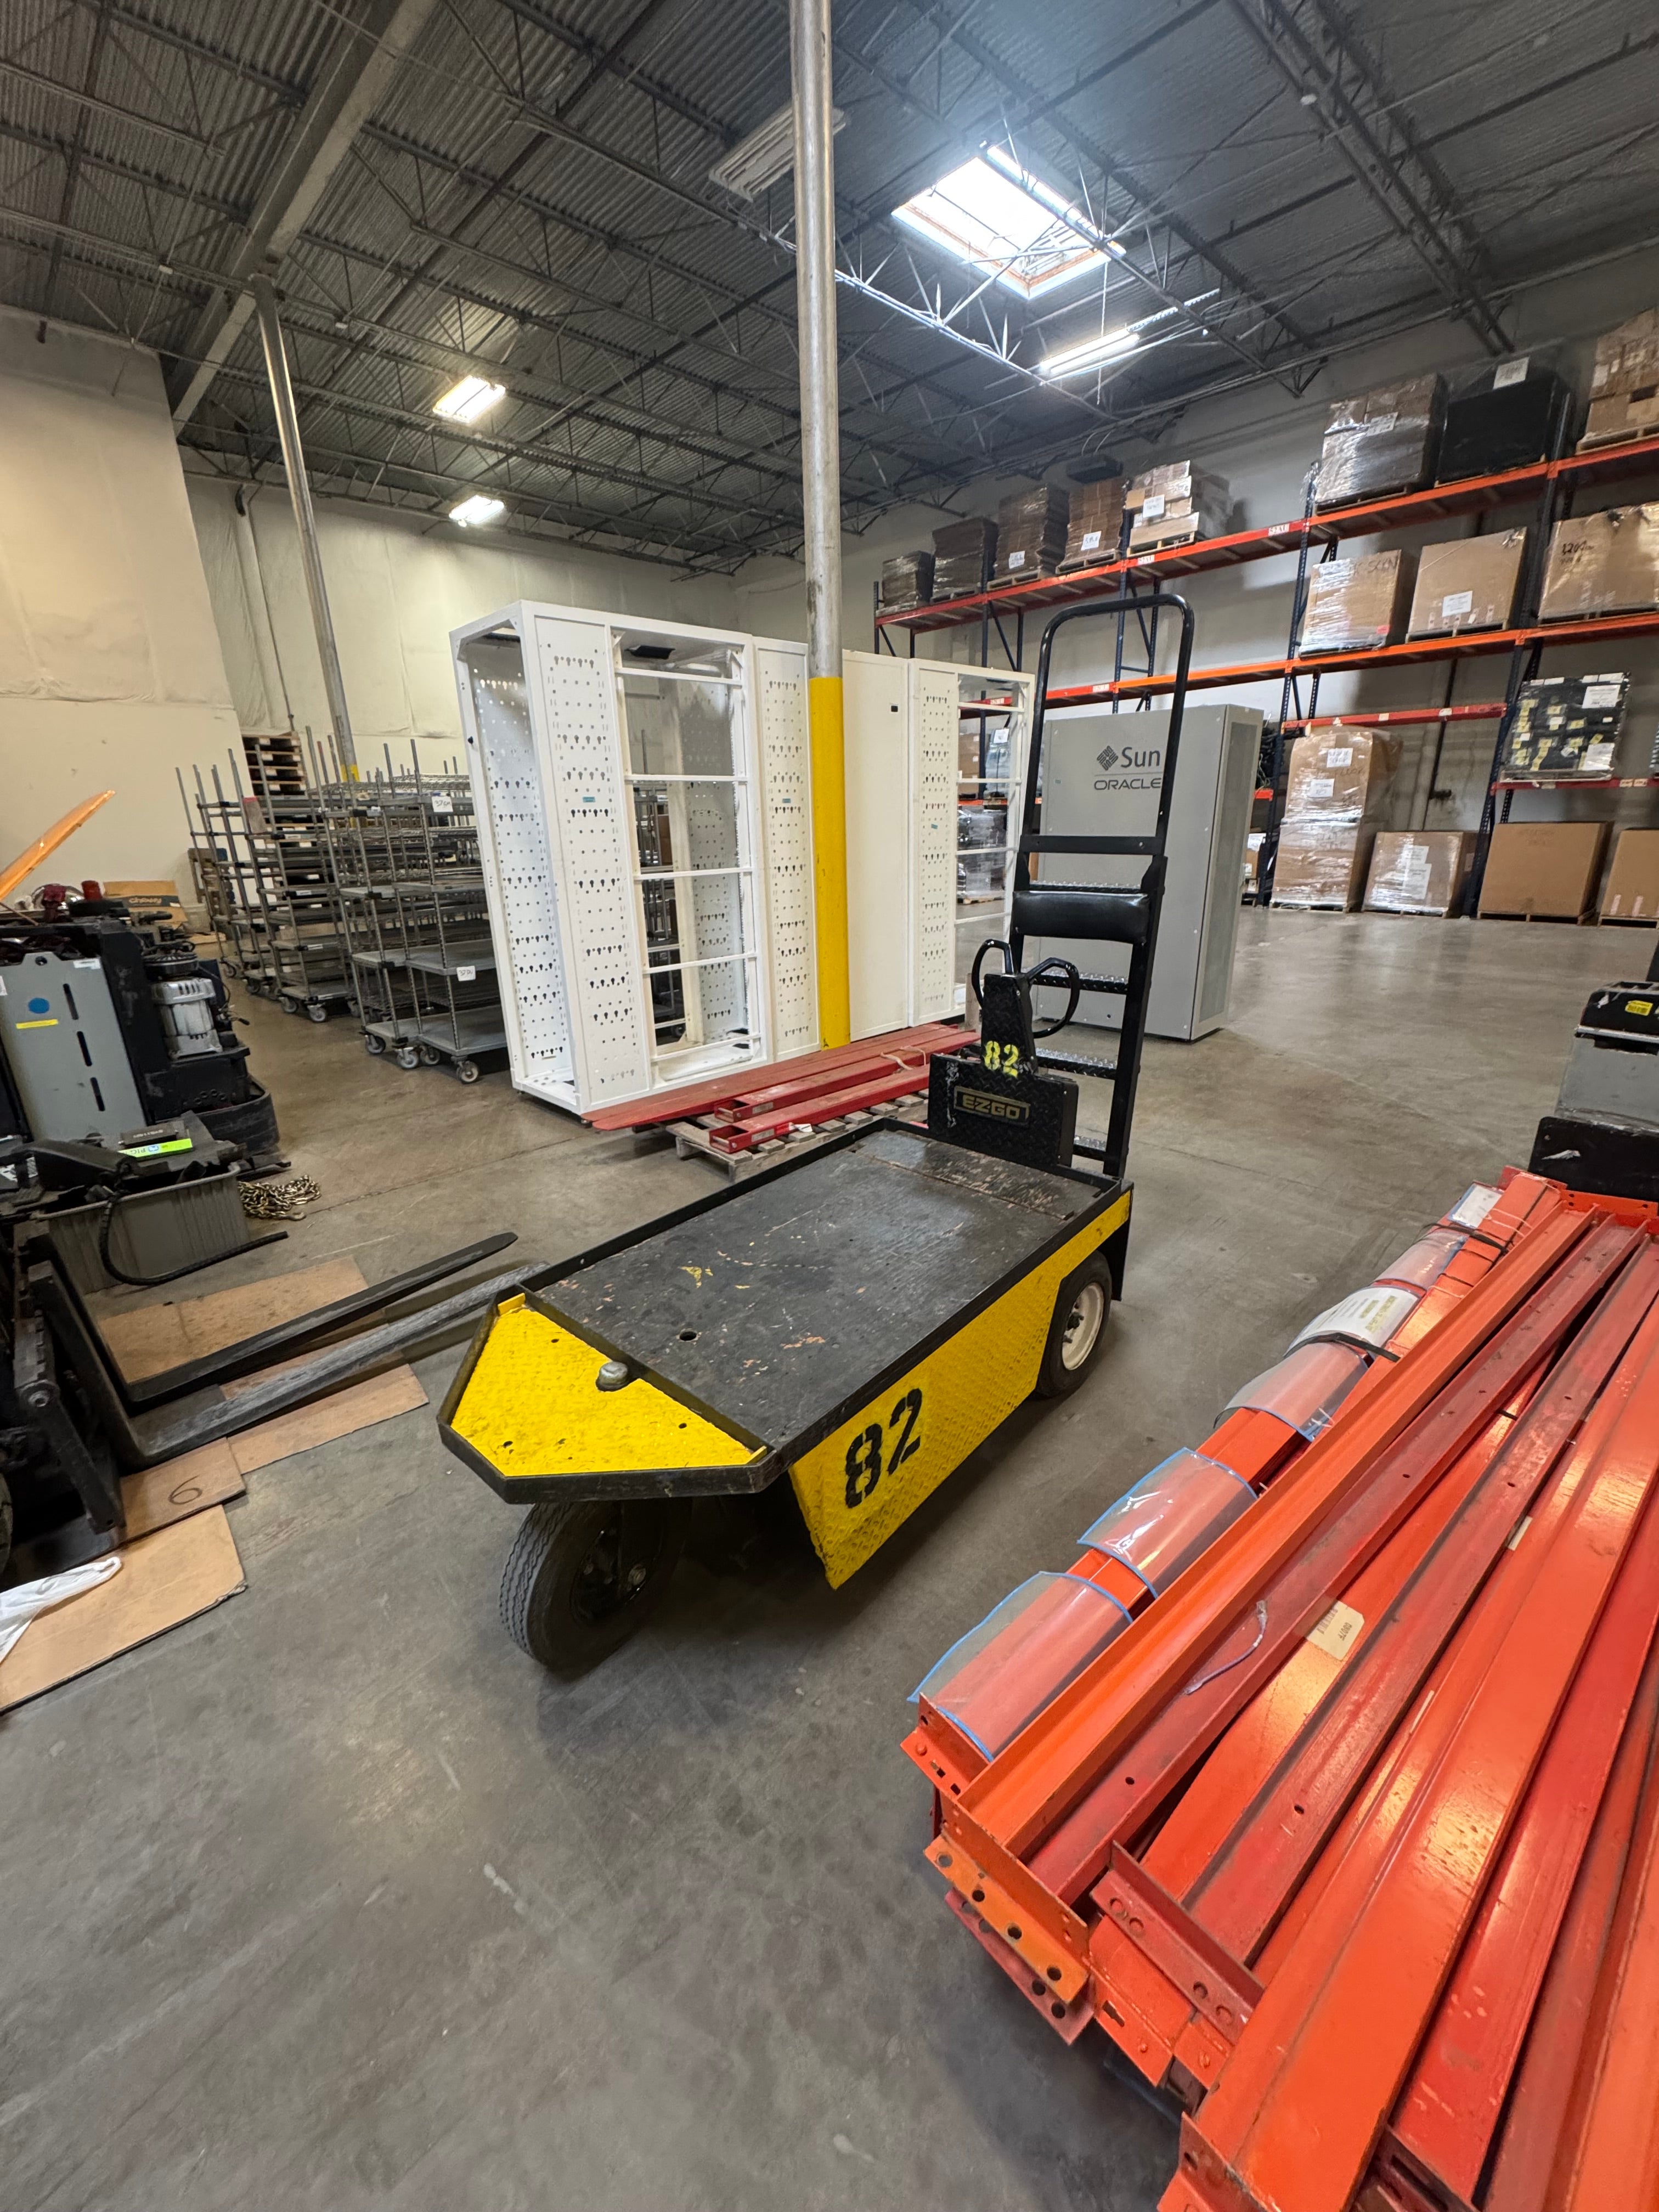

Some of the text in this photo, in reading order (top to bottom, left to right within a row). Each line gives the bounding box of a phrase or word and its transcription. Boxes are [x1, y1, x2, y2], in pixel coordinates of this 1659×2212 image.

[1121, 747, 1160, 768] Sun
[1094, 778, 1162, 790] ORACLE
[984, 1041, 1019, 1078] 82
[962, 1094, 1020, 1119] EZGO
[845, 1388, 922, 1509] 82
[168, 1474, 202, 1505] 6
